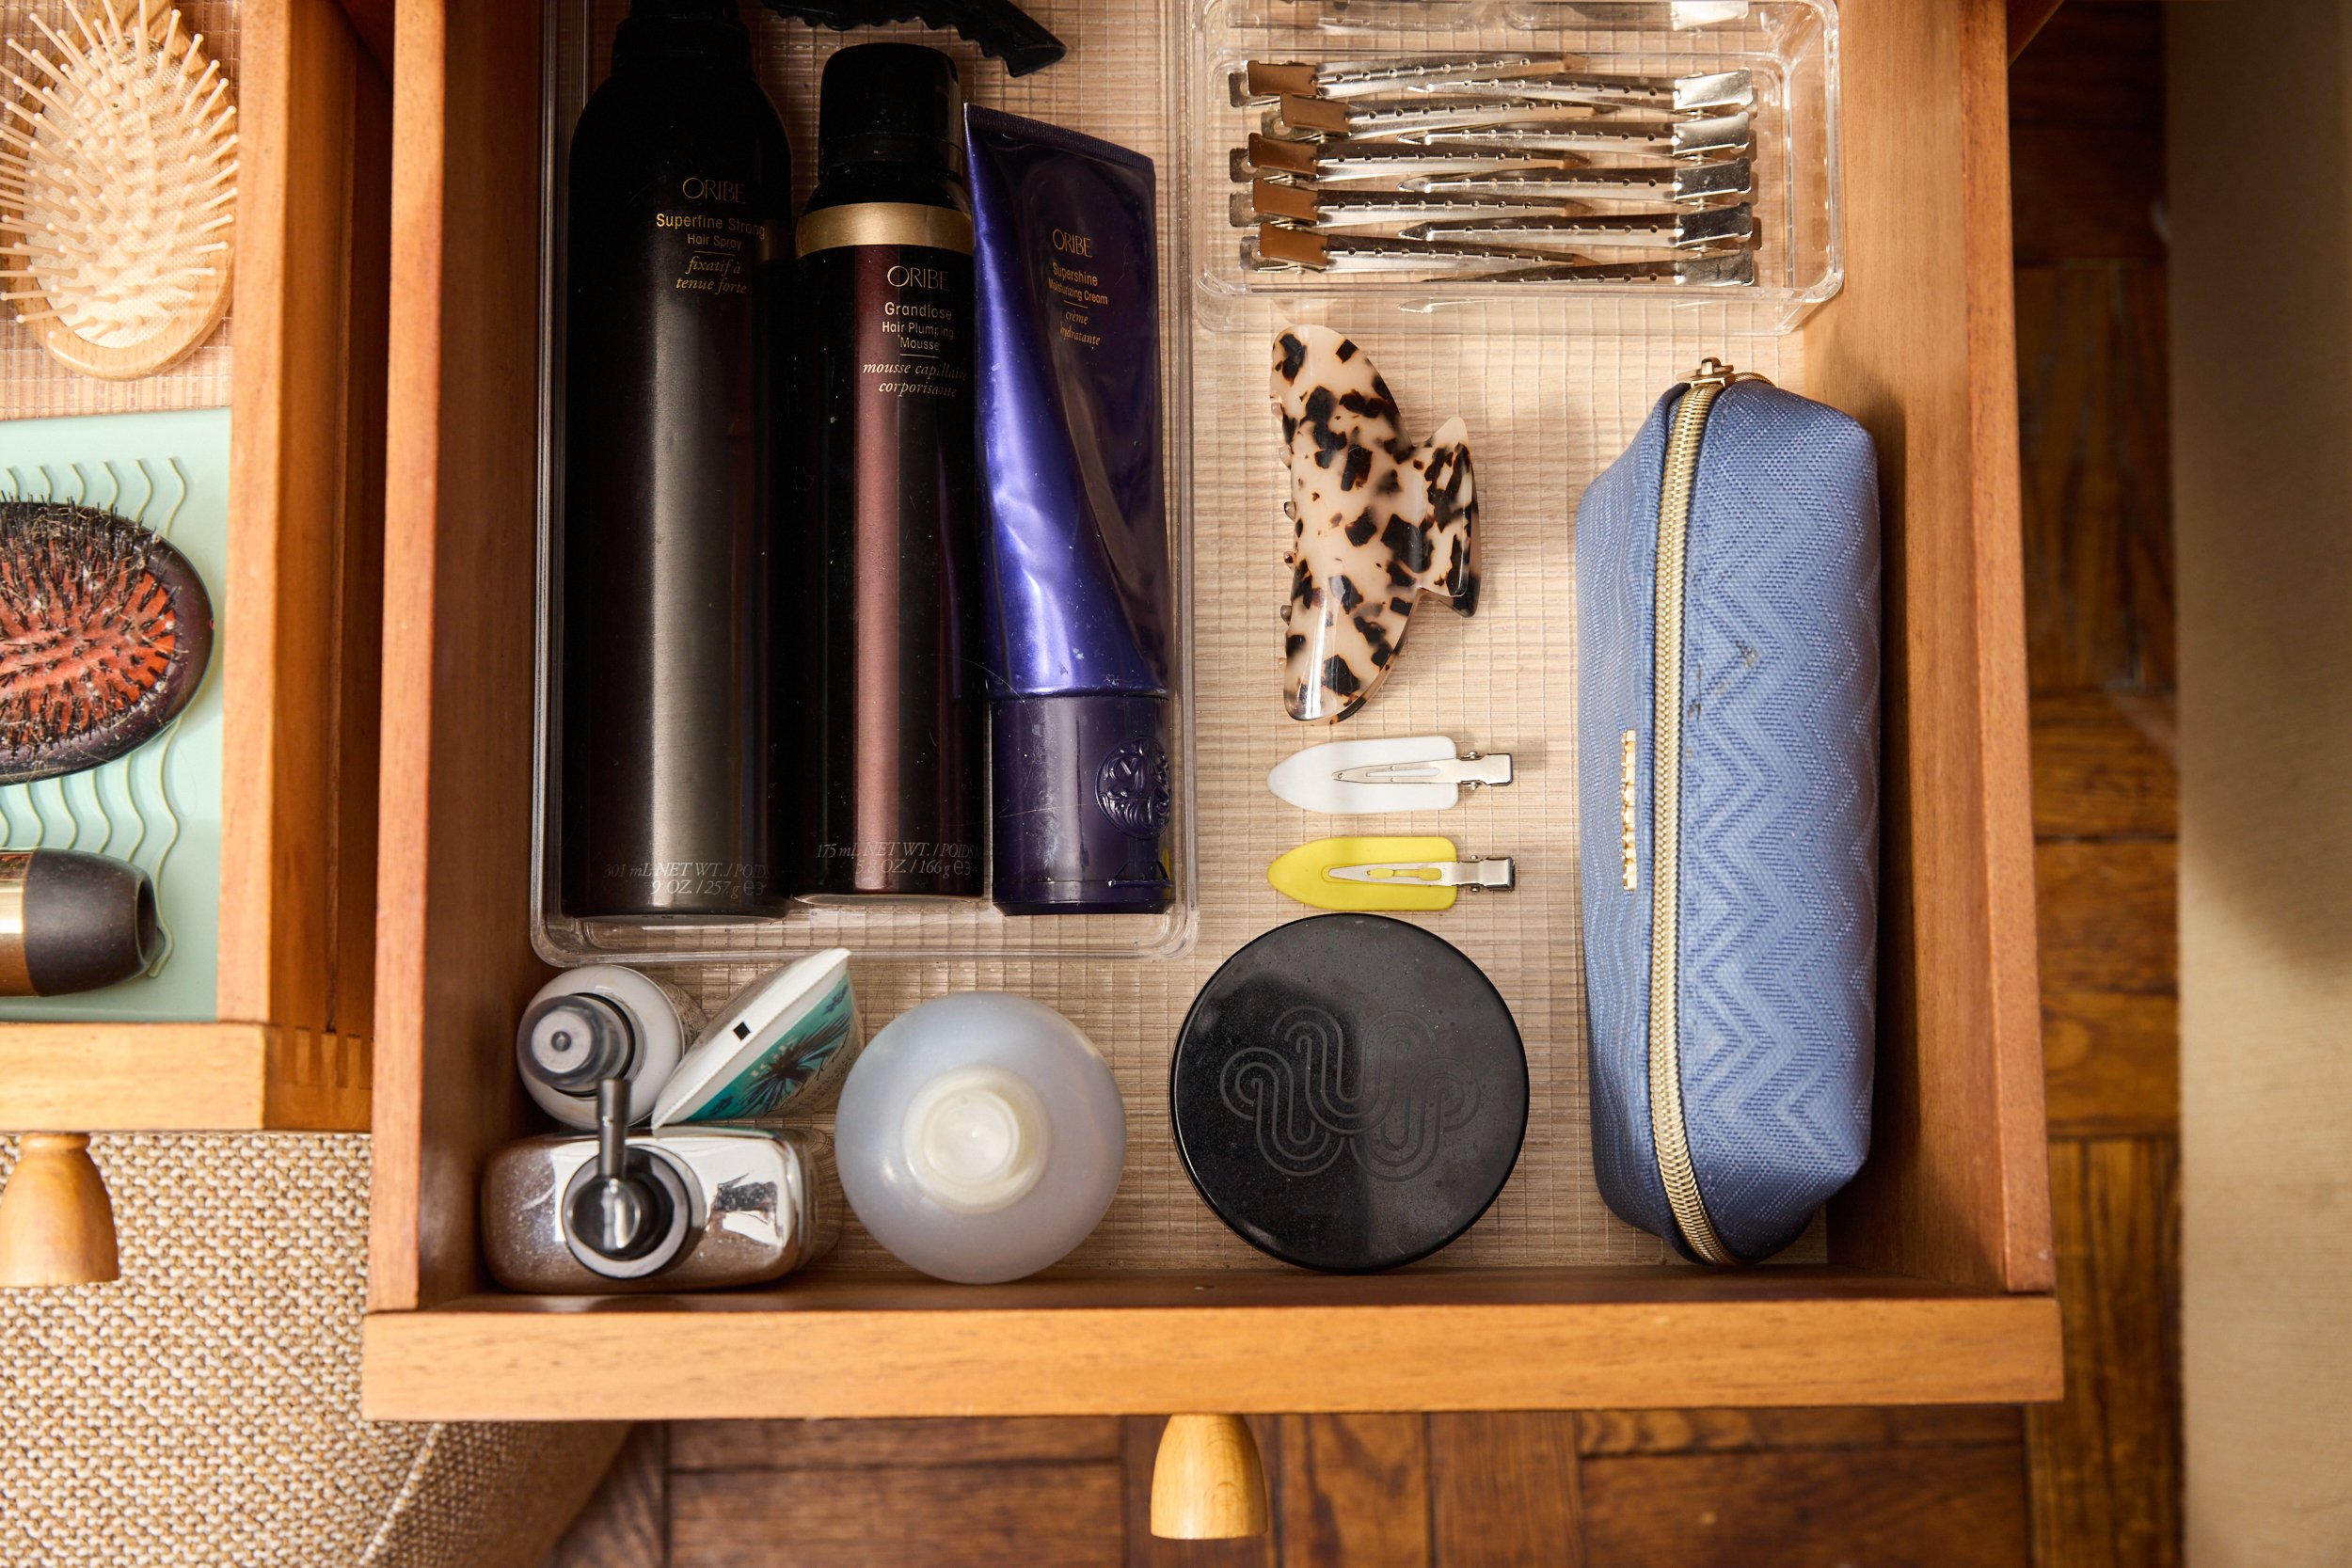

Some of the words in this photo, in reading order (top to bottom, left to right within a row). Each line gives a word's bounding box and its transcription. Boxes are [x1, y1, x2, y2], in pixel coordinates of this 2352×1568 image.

[682, 177, 746, 204] ORIBE
[656, 213, 723, 230] Superfine
[728, 217, 766, 240] Strong
[687, 233, 709, 245] Hair
[713, 235, 741, 251] Spray
[1052, 228, 1093, 258] ORIBE
[685, 255, 734, 277] fixatif
[1052, 261, 1098, 287] Supershine
[675, 277, 715, 290] tenue
[715, 277, 748, 295] forte
[886, 265, 949, 292] ORIBE
[1048, 277, 1083, 301] Moisturizing
[1084, 290, 1108, 305] Cream
[884, 301, 952, 321] Grandiose
[1065, 309, 1089, 325] crème
[882, 322, 905, 333] Hair
[908, 322, 955, 341] Plumping
[1059, 322, 1101, 346] hydratante
[899, 337, 940, 351] Mousse
[862, 363, 912, 374] mousse
[817, 843, 836, 858] 175
[838, 842, 860, 857] mL
[863, 841, 900, 856] NET
[902, 842, 930, 857] WT.
[603, 863, 627, 879] 301
[629, 863, 653, 878] mL
[656, 862, 692, 877] NET
[880, 859, 907, 874] OZ.
[919, 859, 942, 874] 166
[650, 879, 661, 895] 9
[666, 879, 692, 895] OZ.
